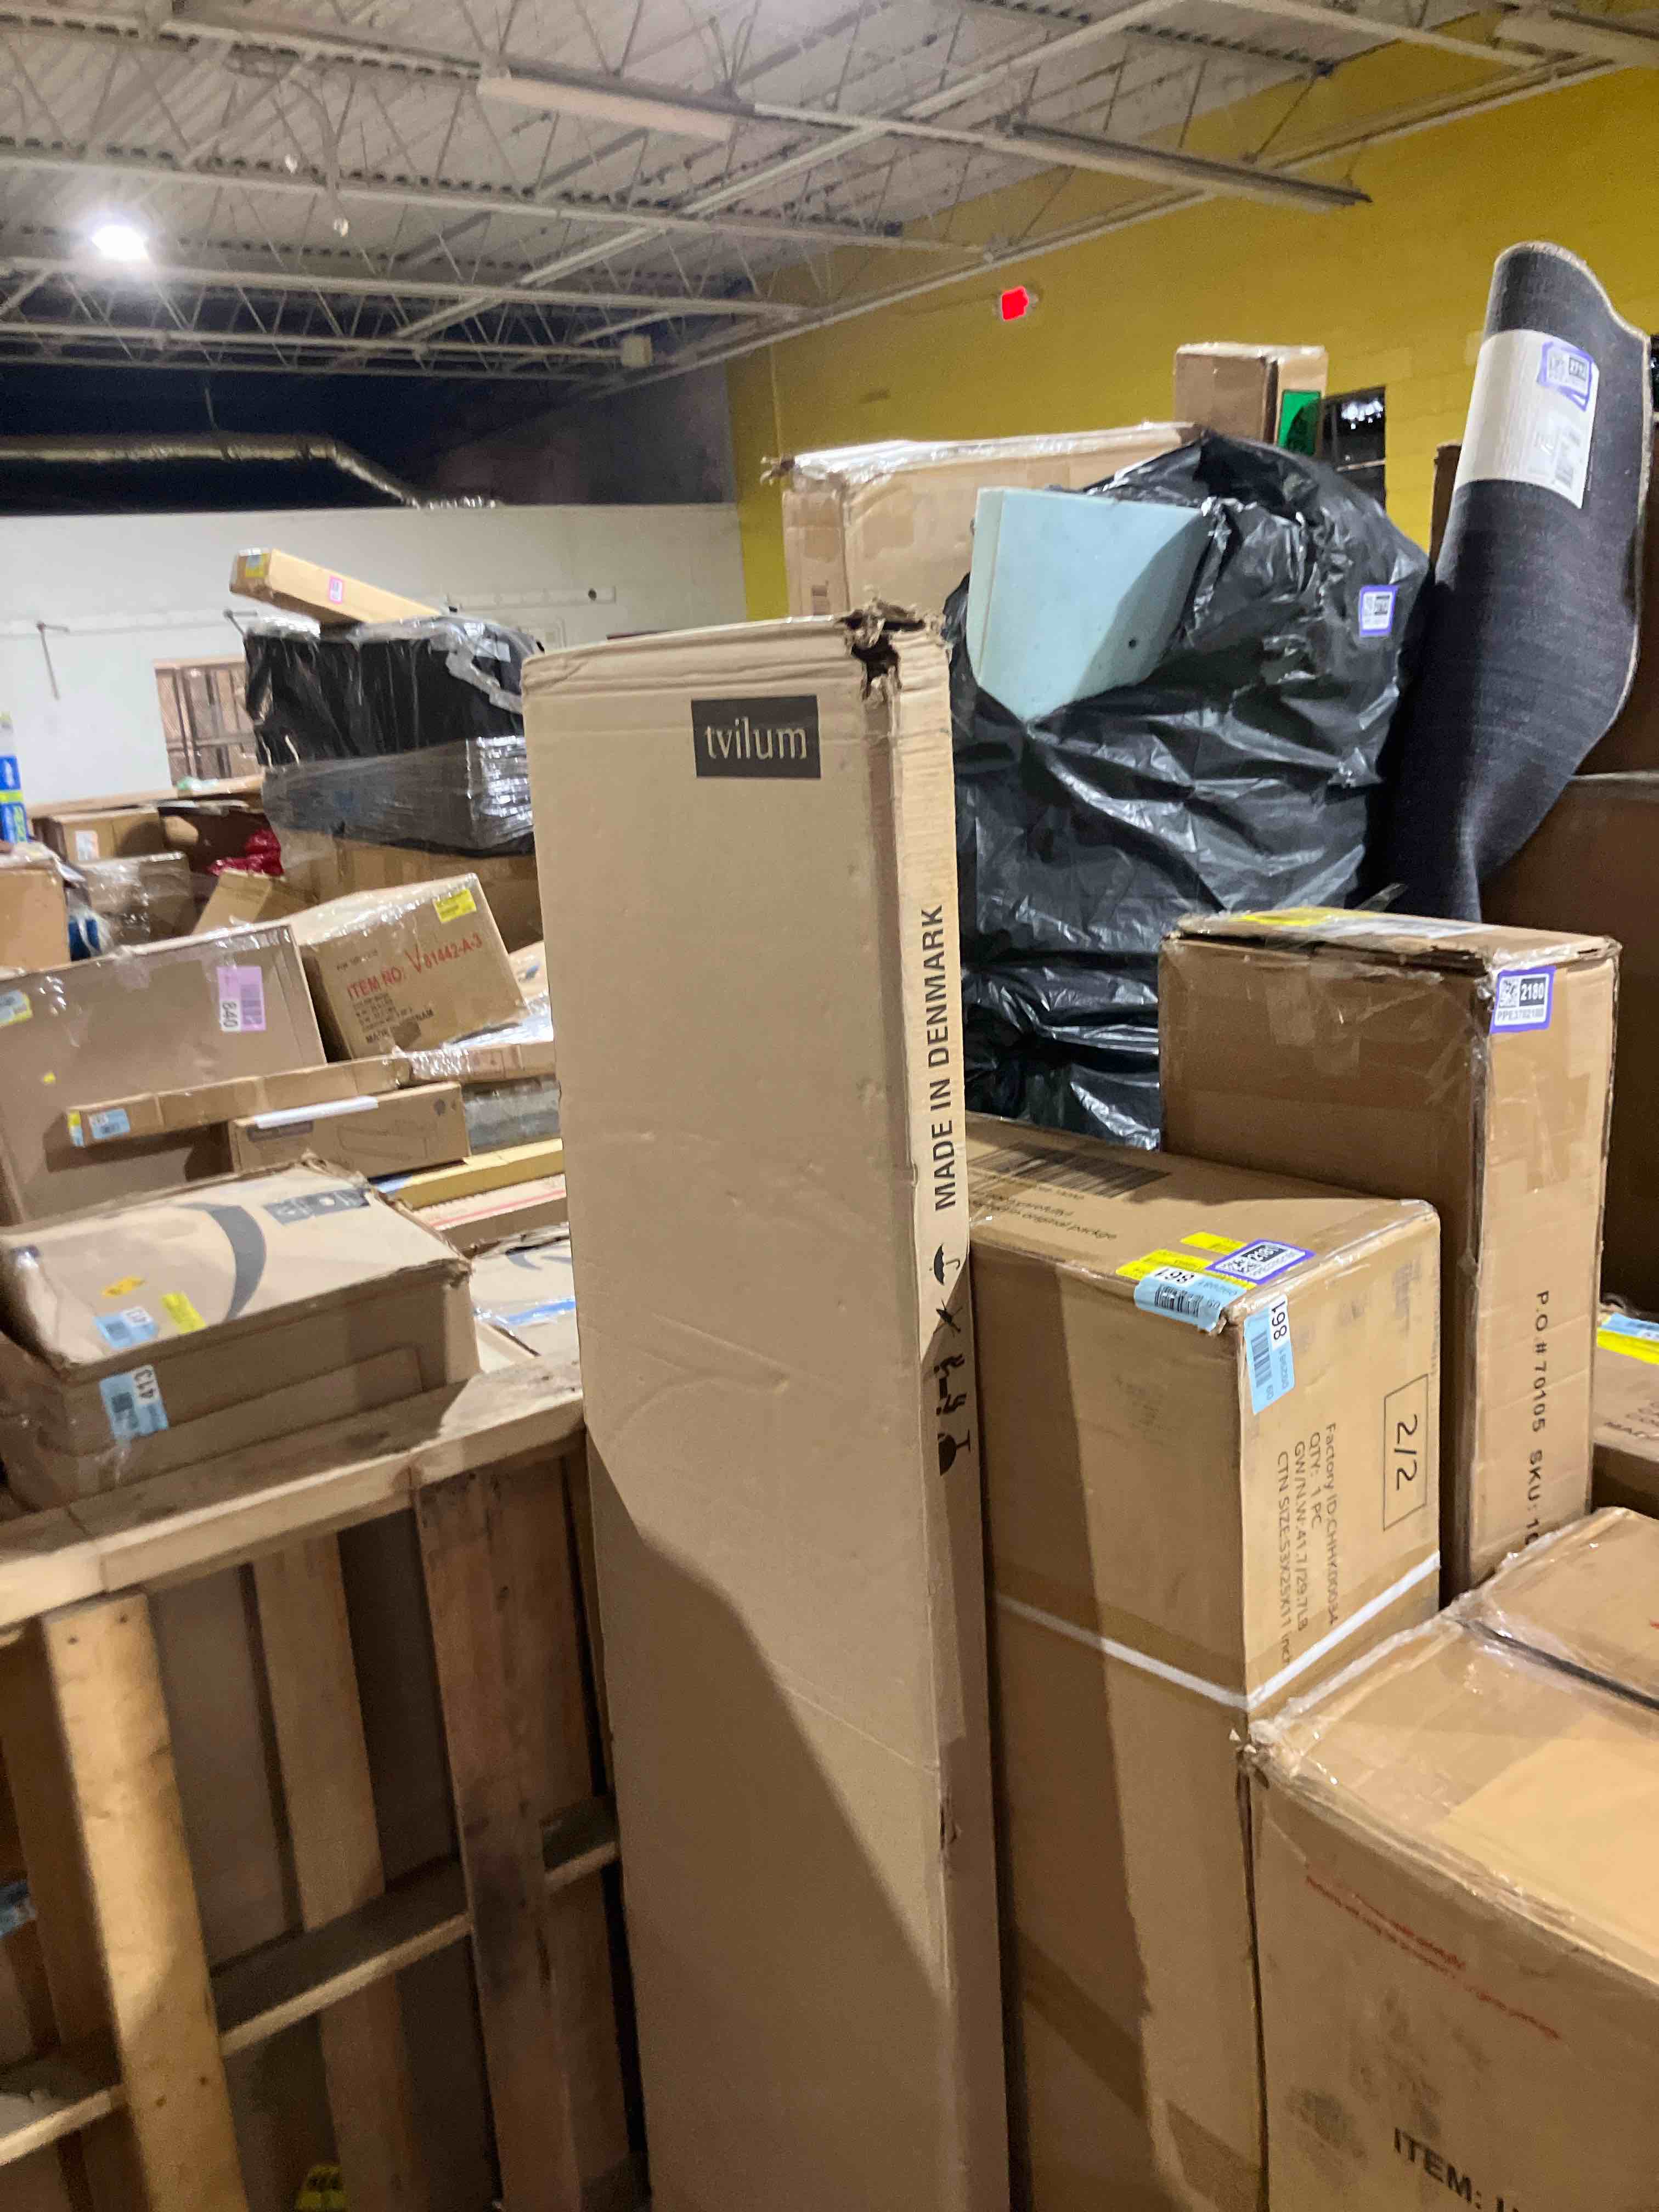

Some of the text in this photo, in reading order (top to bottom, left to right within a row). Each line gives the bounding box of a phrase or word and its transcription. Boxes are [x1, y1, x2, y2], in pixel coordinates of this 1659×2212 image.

[704, 715, 808, 760] tvilum
[347, 975, 382, 1000] ITEM
[921, 905, 956, 1211] MADE IN DENMARK
[1270, 1299, 1288, 1340] 861
[1532, 1360, 1547, 1433] 70105
[1277, 1451, 1289, 1493] CTN
[1309, 1431, 1321, 1477] QTY:
[1324, 1422, 1336, 1489] Factory
[1394, 1413, 1418, 1491] 2/2
[1311, 1502, 1322, 1530] PC
[1393, 2126, 1482, 2209] ITEM:
